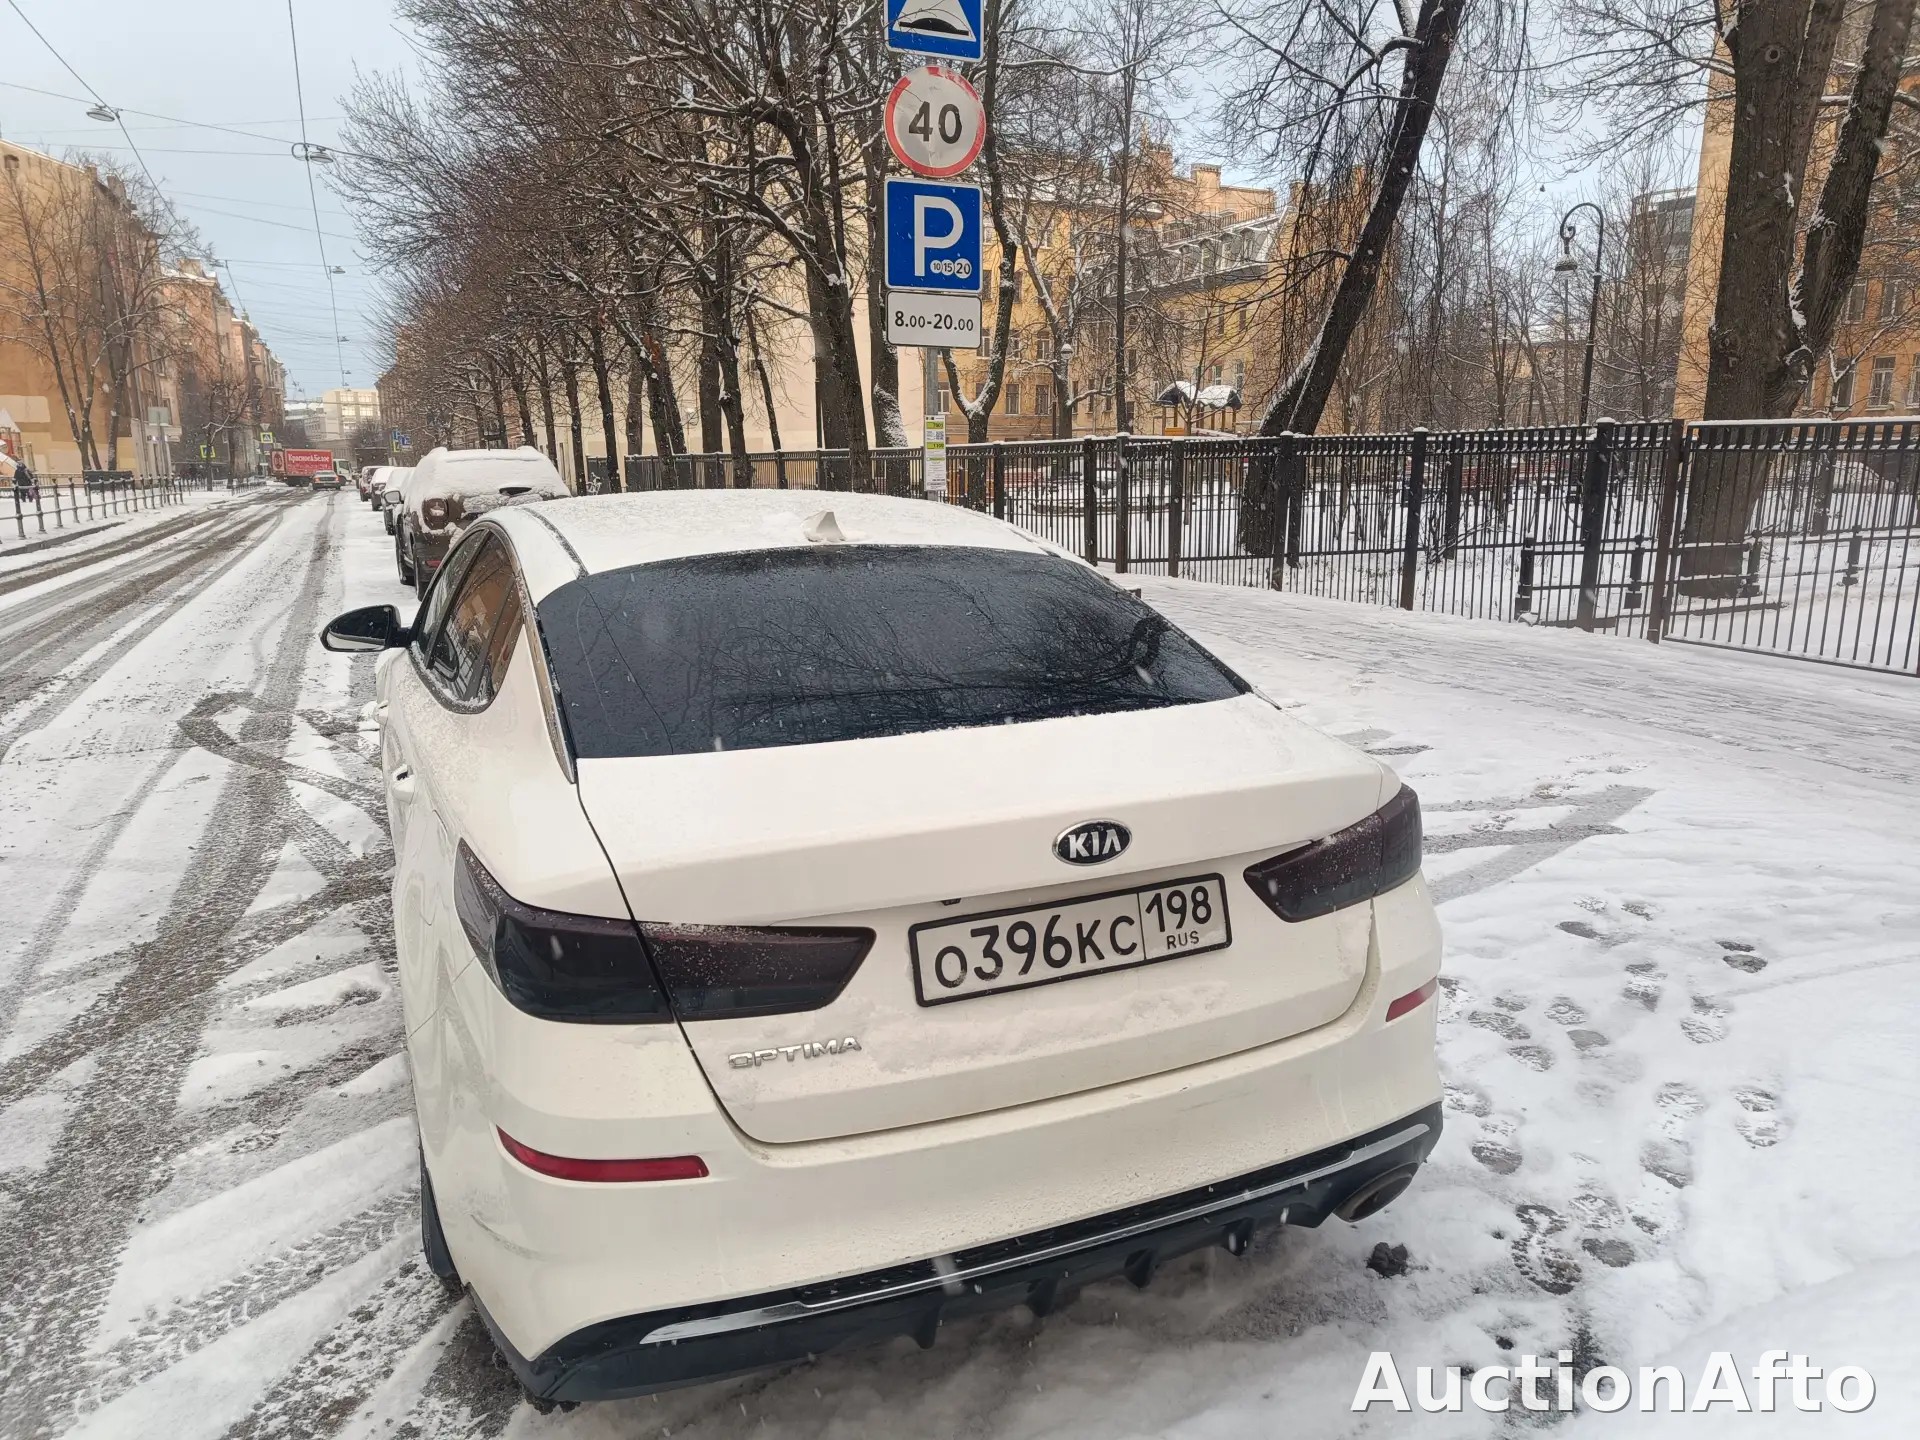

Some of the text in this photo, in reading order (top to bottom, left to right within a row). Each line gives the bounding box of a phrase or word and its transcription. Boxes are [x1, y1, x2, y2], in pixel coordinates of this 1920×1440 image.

[908, 100, 963, 145] 40
[913, 194, 964, 277] P
[955, 262, 971, 275] 20
[1067, 827, 1123, 859] KIA
[1145, 885, 1212, 934] 198
[1166, 930, 1200, 950] RUS
[728, 1036, 862, 1068] OPTIMA
